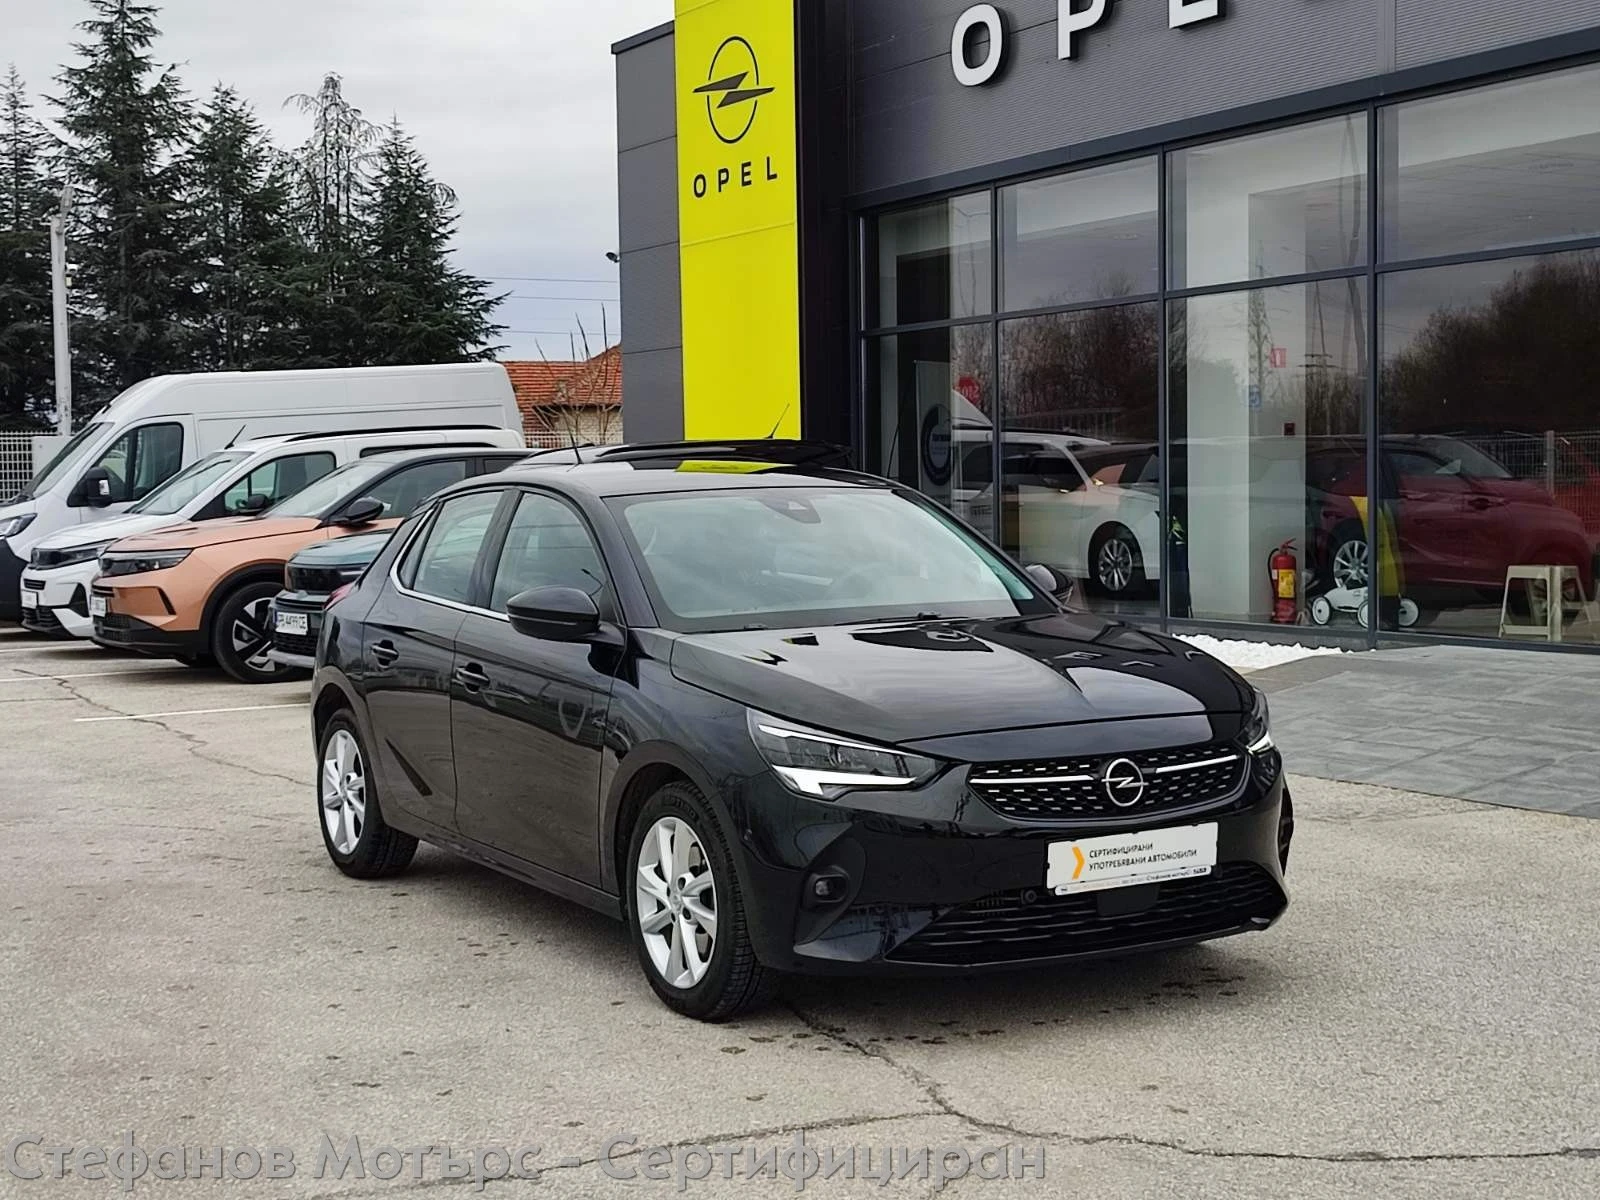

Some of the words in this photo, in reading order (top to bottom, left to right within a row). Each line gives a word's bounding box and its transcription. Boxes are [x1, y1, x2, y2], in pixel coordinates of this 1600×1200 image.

[693, 156, 778, 198] OPEL
[1088, 855, 1147, 871] УПОТРЕБЯВАНИ
[1147, 848, 1198, 864] АВТОМОБИЛИ
[1089, 842, 1154, 859] СЕРТИФИЦИРАНИ
